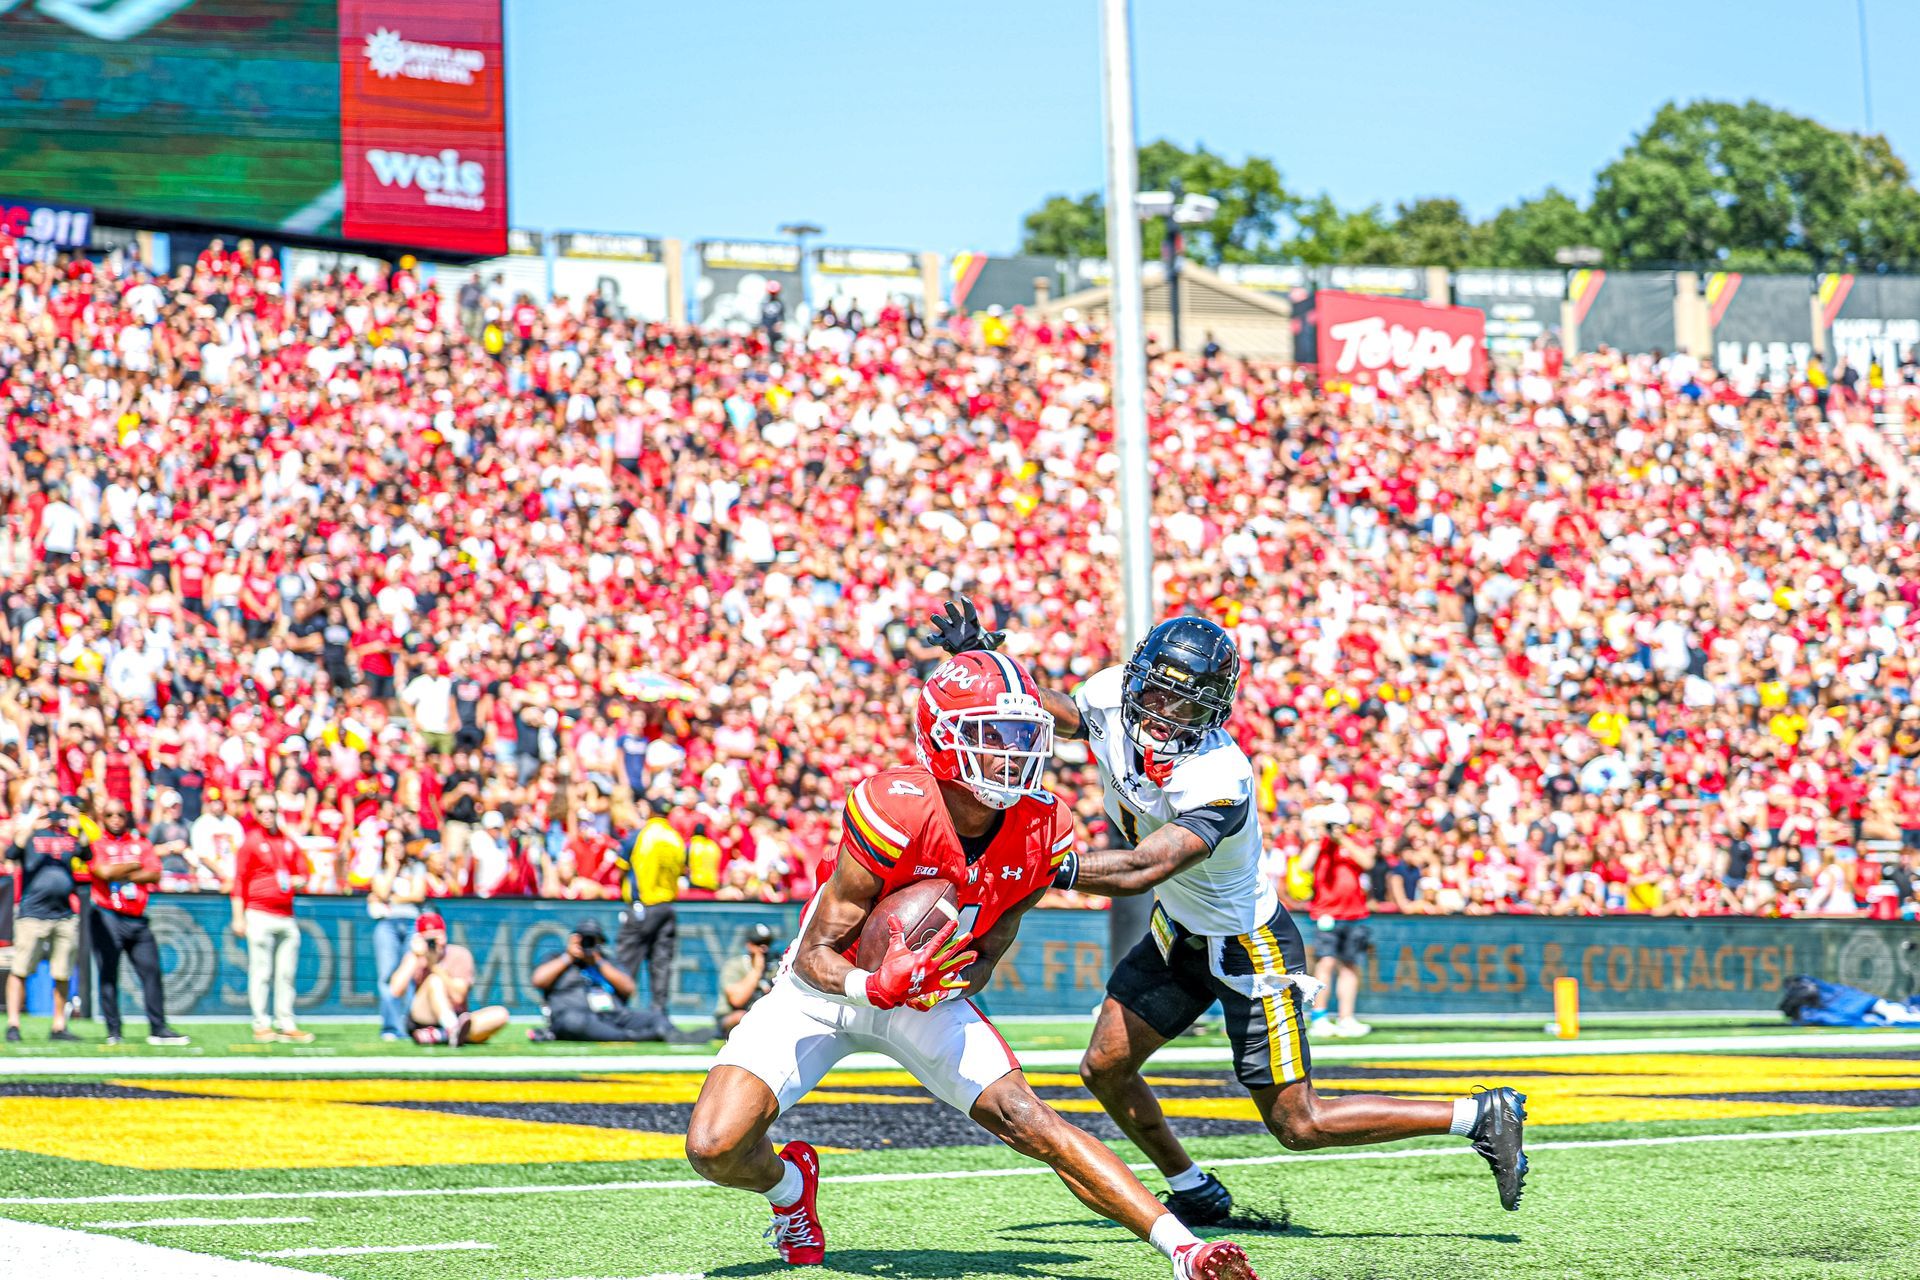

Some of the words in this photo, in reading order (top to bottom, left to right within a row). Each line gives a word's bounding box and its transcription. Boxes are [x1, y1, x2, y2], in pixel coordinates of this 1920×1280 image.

[1330, 316, 1475, 383] Terps
[931, 660, 981, 690] erps
[887, 780, 925, 797] 4
[1043, 940, 1104, 993] FR
[1352, 943, 1528, 993] LASSES
